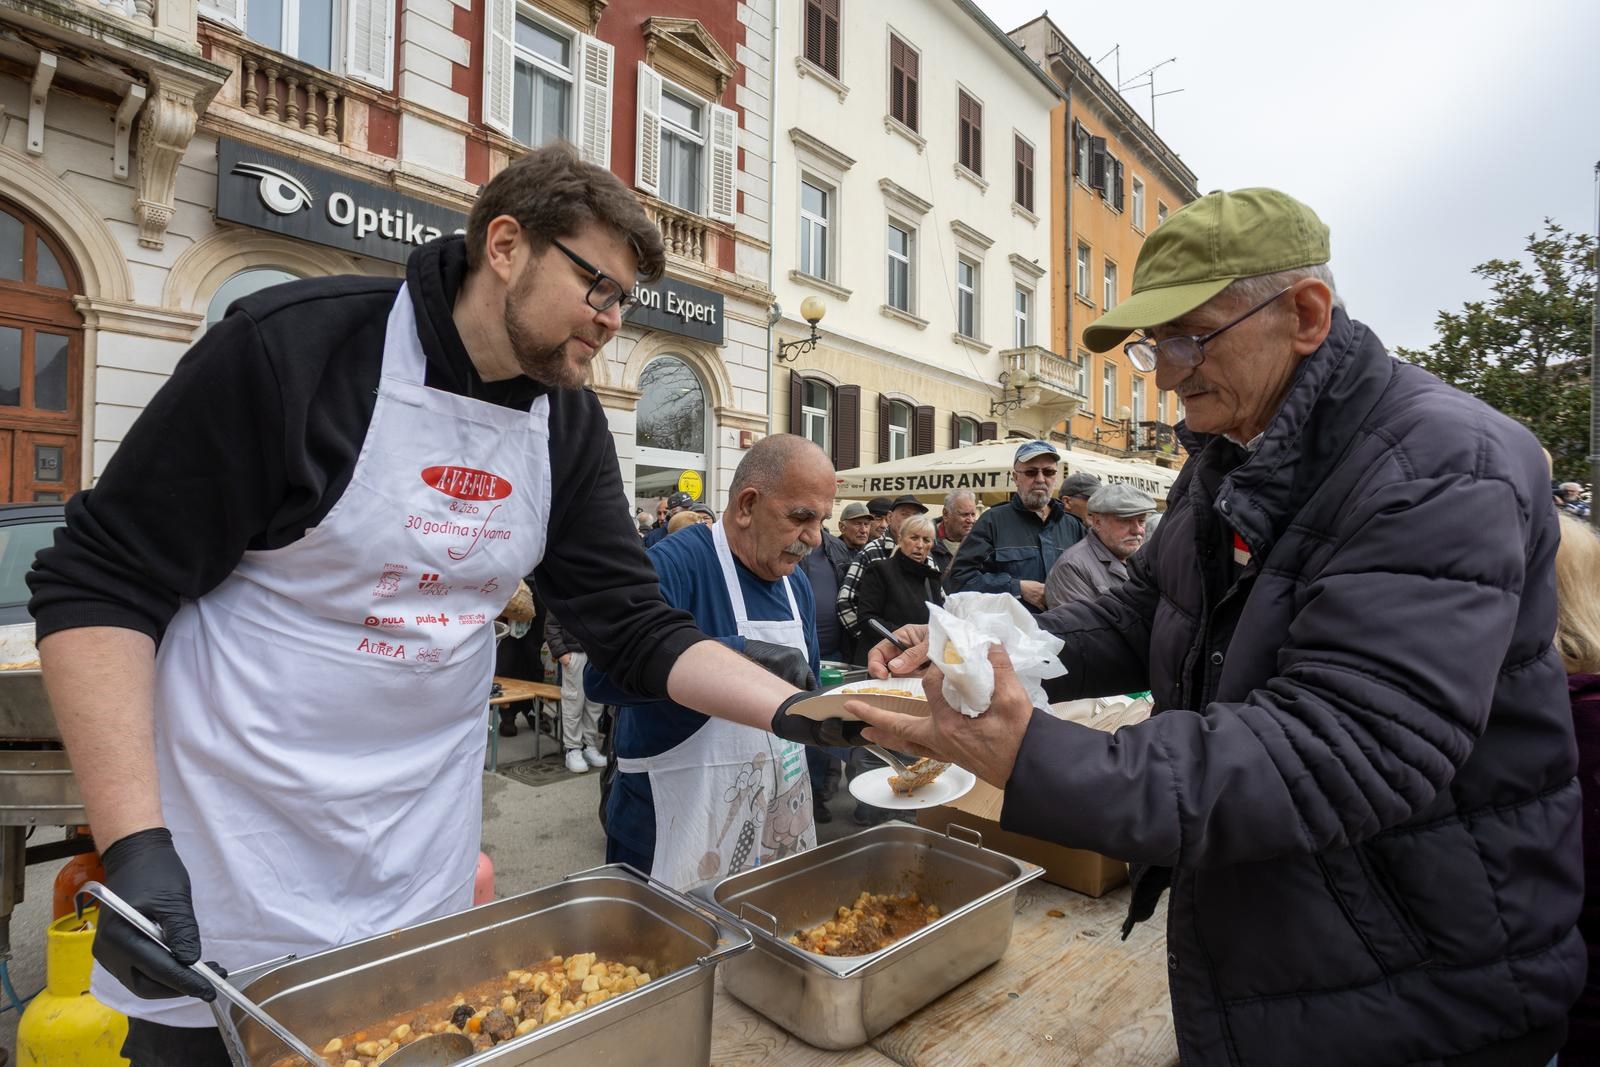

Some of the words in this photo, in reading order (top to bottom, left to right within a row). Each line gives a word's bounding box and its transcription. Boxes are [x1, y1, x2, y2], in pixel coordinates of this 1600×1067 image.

[327, 191, 442, 245] Optika
[667, 291, 716, 324] Expert
[870, 472, 1001, 491] RESTAURANT
[449, 501, 458, 511] &
[405, 515, 422, 529] 30
[423, 521, 469, 536] godina
[471, 527, 478, 537] s
[483, 528, 511, 540] vama
[382, 616, 405, 624] PULA
[356, 638, 406, 659] AUREA
